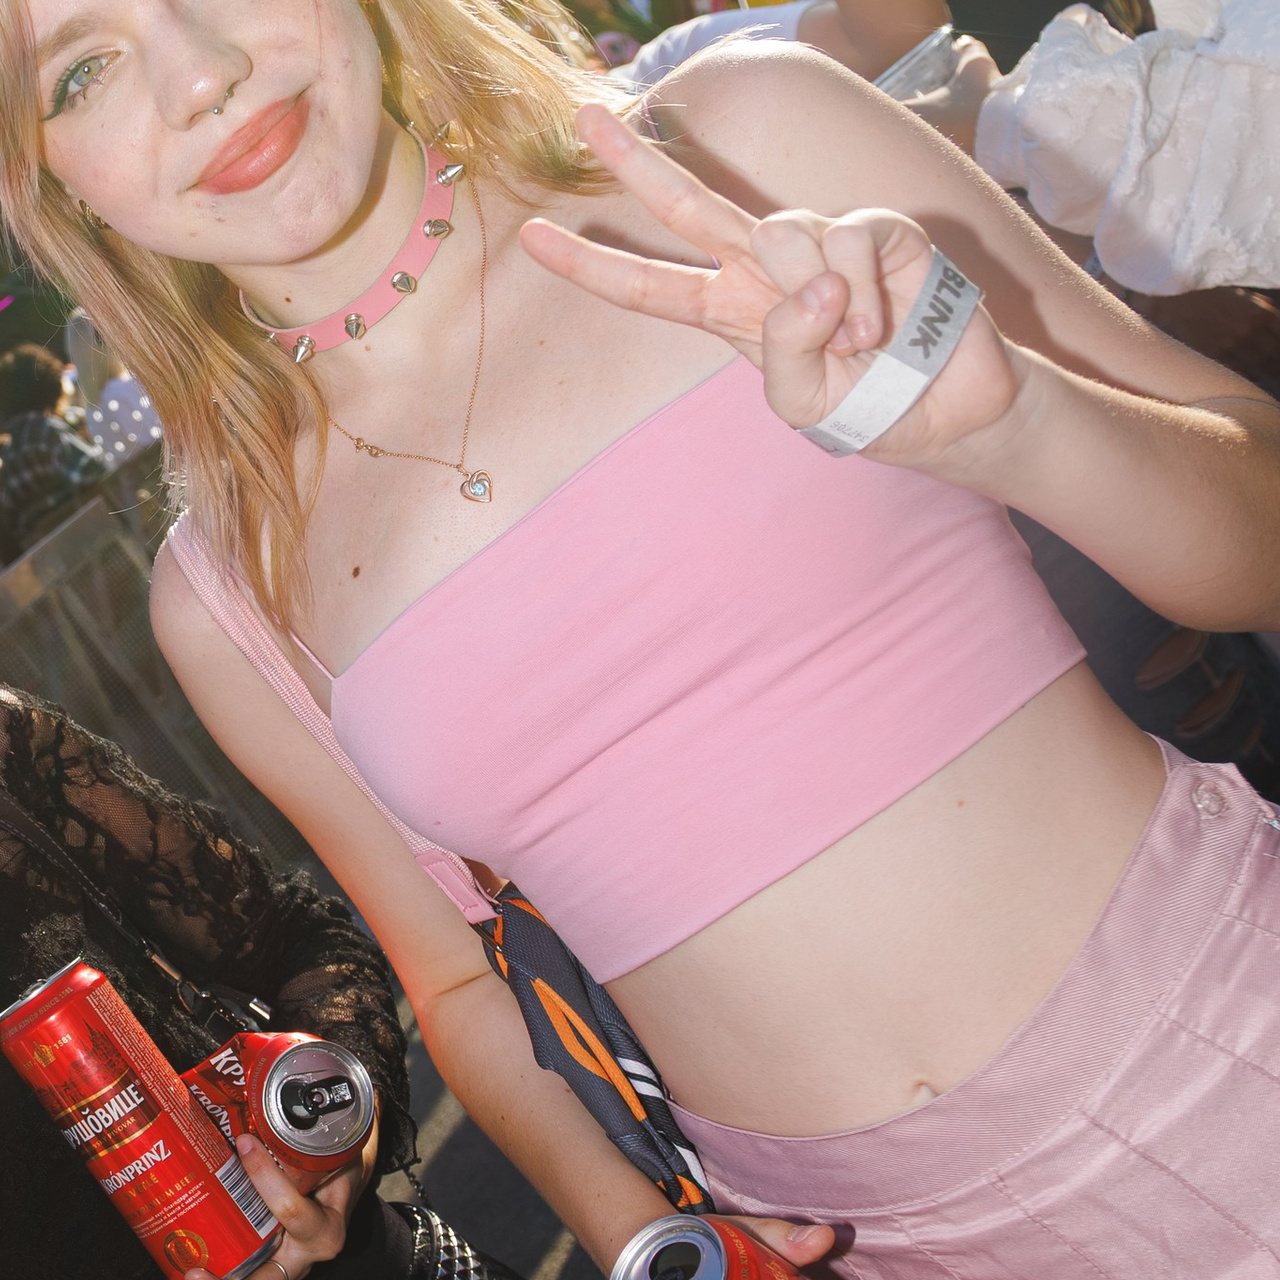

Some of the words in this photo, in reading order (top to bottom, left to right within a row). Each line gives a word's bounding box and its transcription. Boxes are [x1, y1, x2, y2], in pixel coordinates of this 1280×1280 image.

[908, 265, 967, 360] BLINK
[16, 1011, 40, 1030] KINGS
[37, 996, 61, 1015] SINCE
[52, 1033, 73, 1050] 1581
[107, 1116, 137, 1139] PIVOVAR
[99, 1139, 172, 1195] KRÓNPRINZ
[173, 1171, 198, 1191] BEER
[733, 1239, 749, 1265] KINGS
